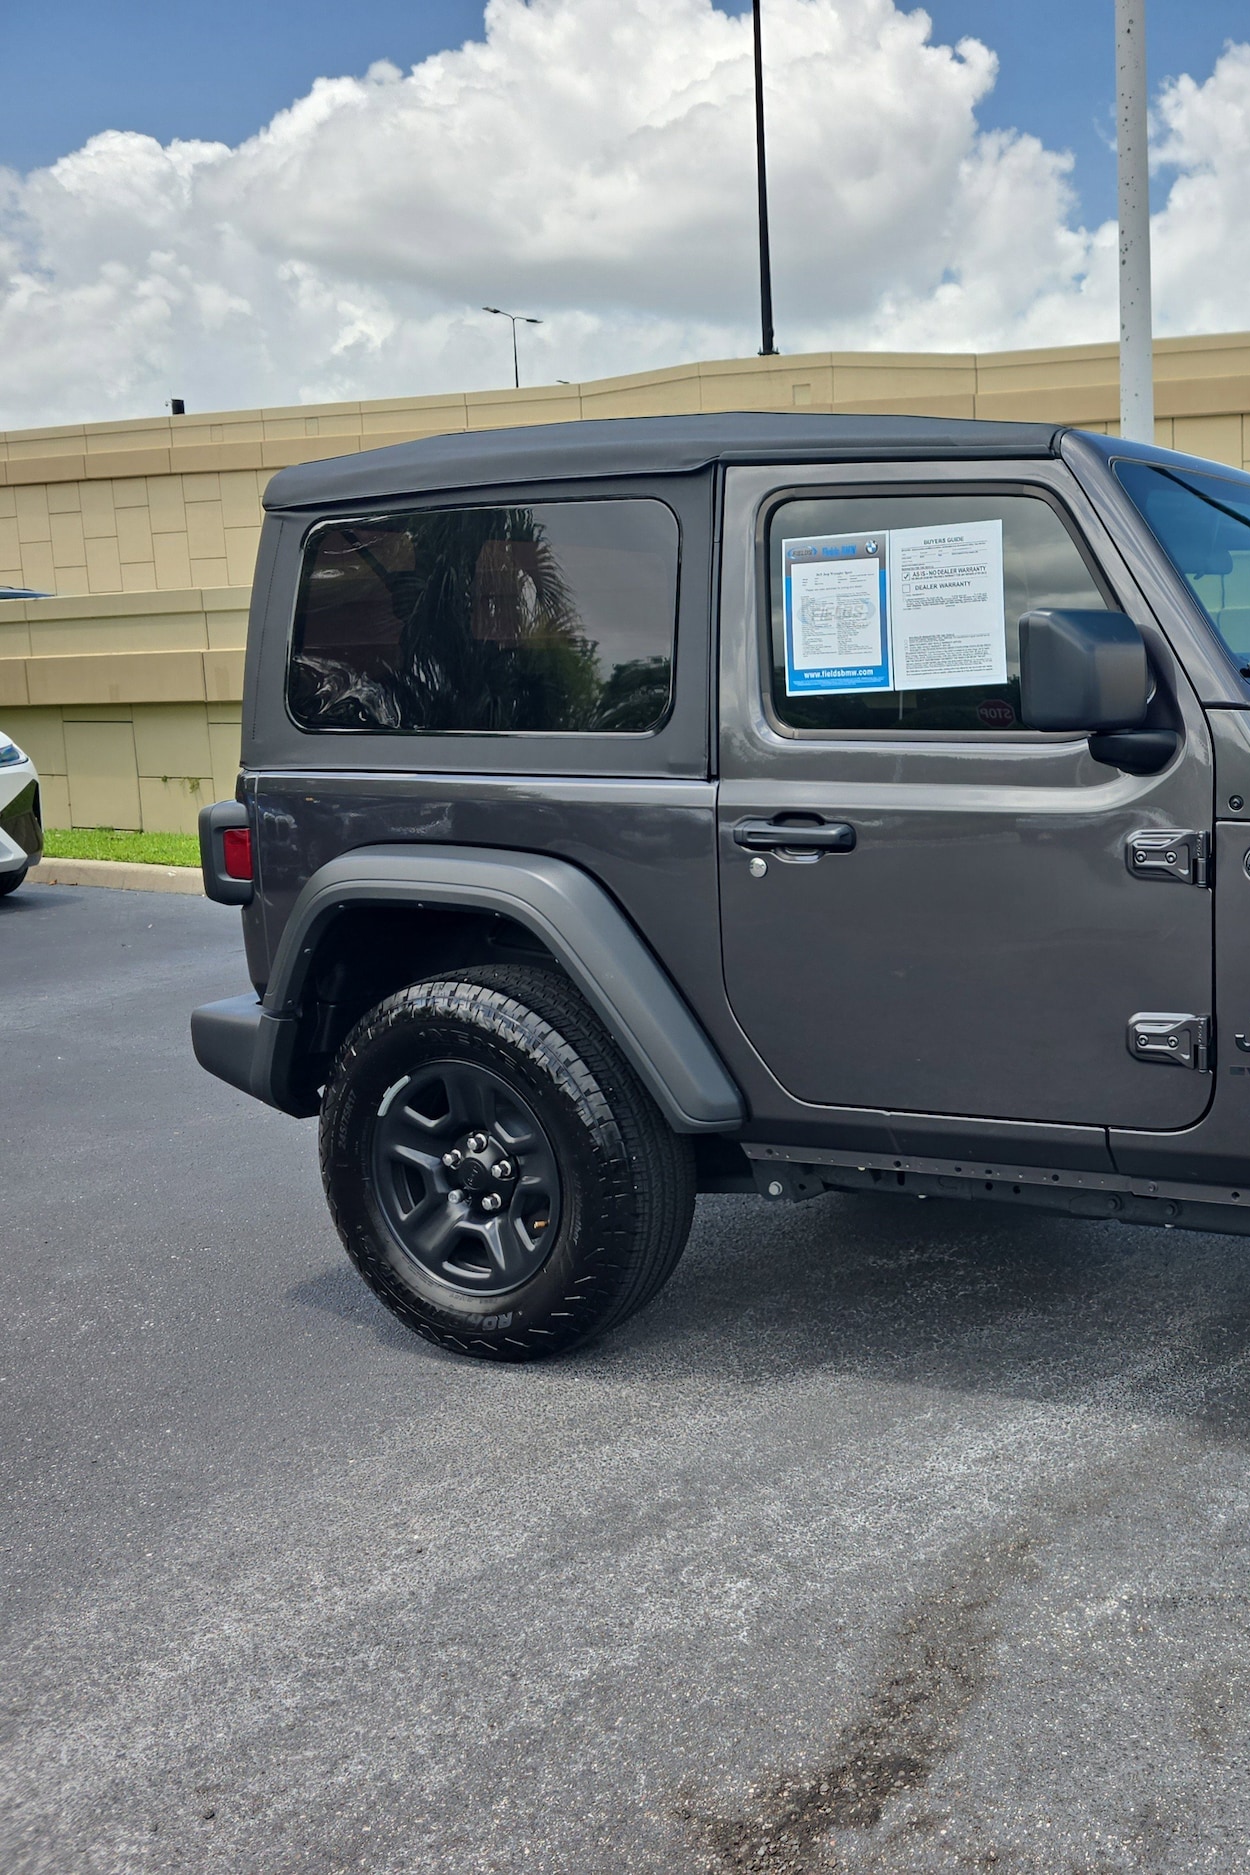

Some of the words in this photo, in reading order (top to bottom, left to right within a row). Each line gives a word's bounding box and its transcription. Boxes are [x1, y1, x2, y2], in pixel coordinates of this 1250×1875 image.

[923, 537, 946, 545] BUYERS
[937, 567, 957, 575] DEALER
[958, 565, 986, 573] WARRANTY
[915, 582, 937, 591] DEALER
[939, 580, 971, 589] WARRANTY
[803, 669, 874, 679] www.fieldsbmw.com
